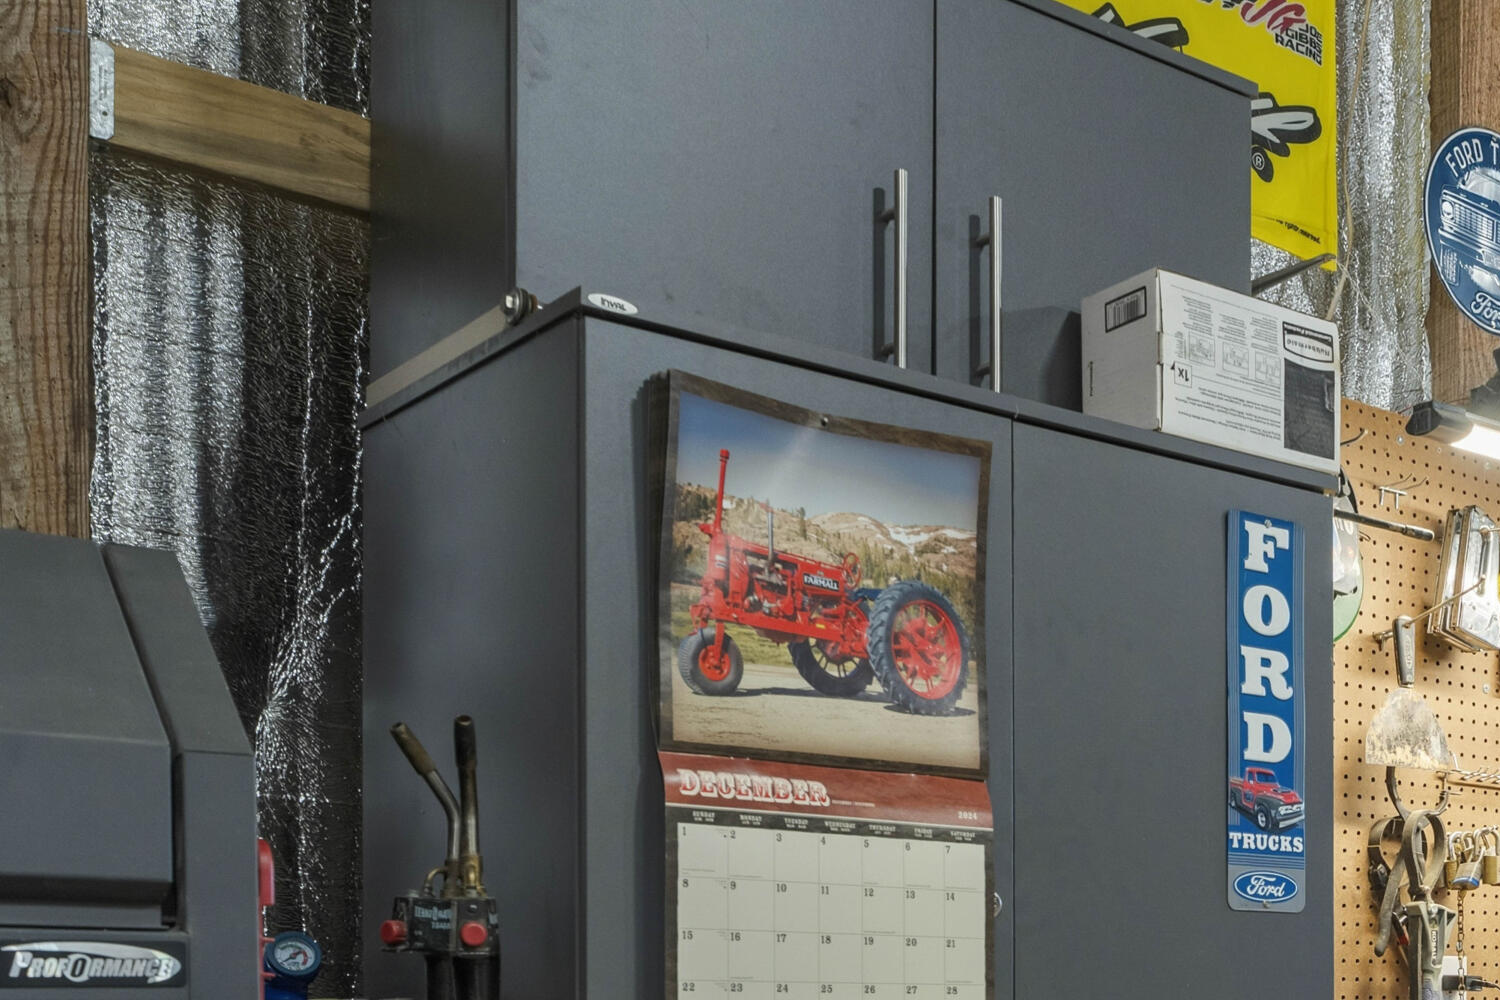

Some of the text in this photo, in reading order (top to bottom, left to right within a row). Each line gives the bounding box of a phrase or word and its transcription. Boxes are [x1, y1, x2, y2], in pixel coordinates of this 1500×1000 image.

[1275, 33, 1322, 66] RACING
[1445, 137, 1484, 178] FORD
[803, 574, 840, 592] FARMALL
[1239, 519, 1294, 764] FORD
[677, 768, 831, 808] DECEMBER
[682, 826, 687, 837] 1
[730, 830, 736, 839] 2
[776, 833, 782, 842] 3
[864, 839, 869, 848] 5
[905, 842, 911, 851] 6
[945, 845, 951, 854] 7
[1229, 831, 1304, 853] TRUCKS
[683, 879, 955, 901] 8 9 10 11 12 13 14
[1246, 875, 1286, 899] Ford
[682, 931, 955, 948] 15 16 17 18 19 20 21
[682, 983, 957, 995] 22 23 24 25 26 27 28
